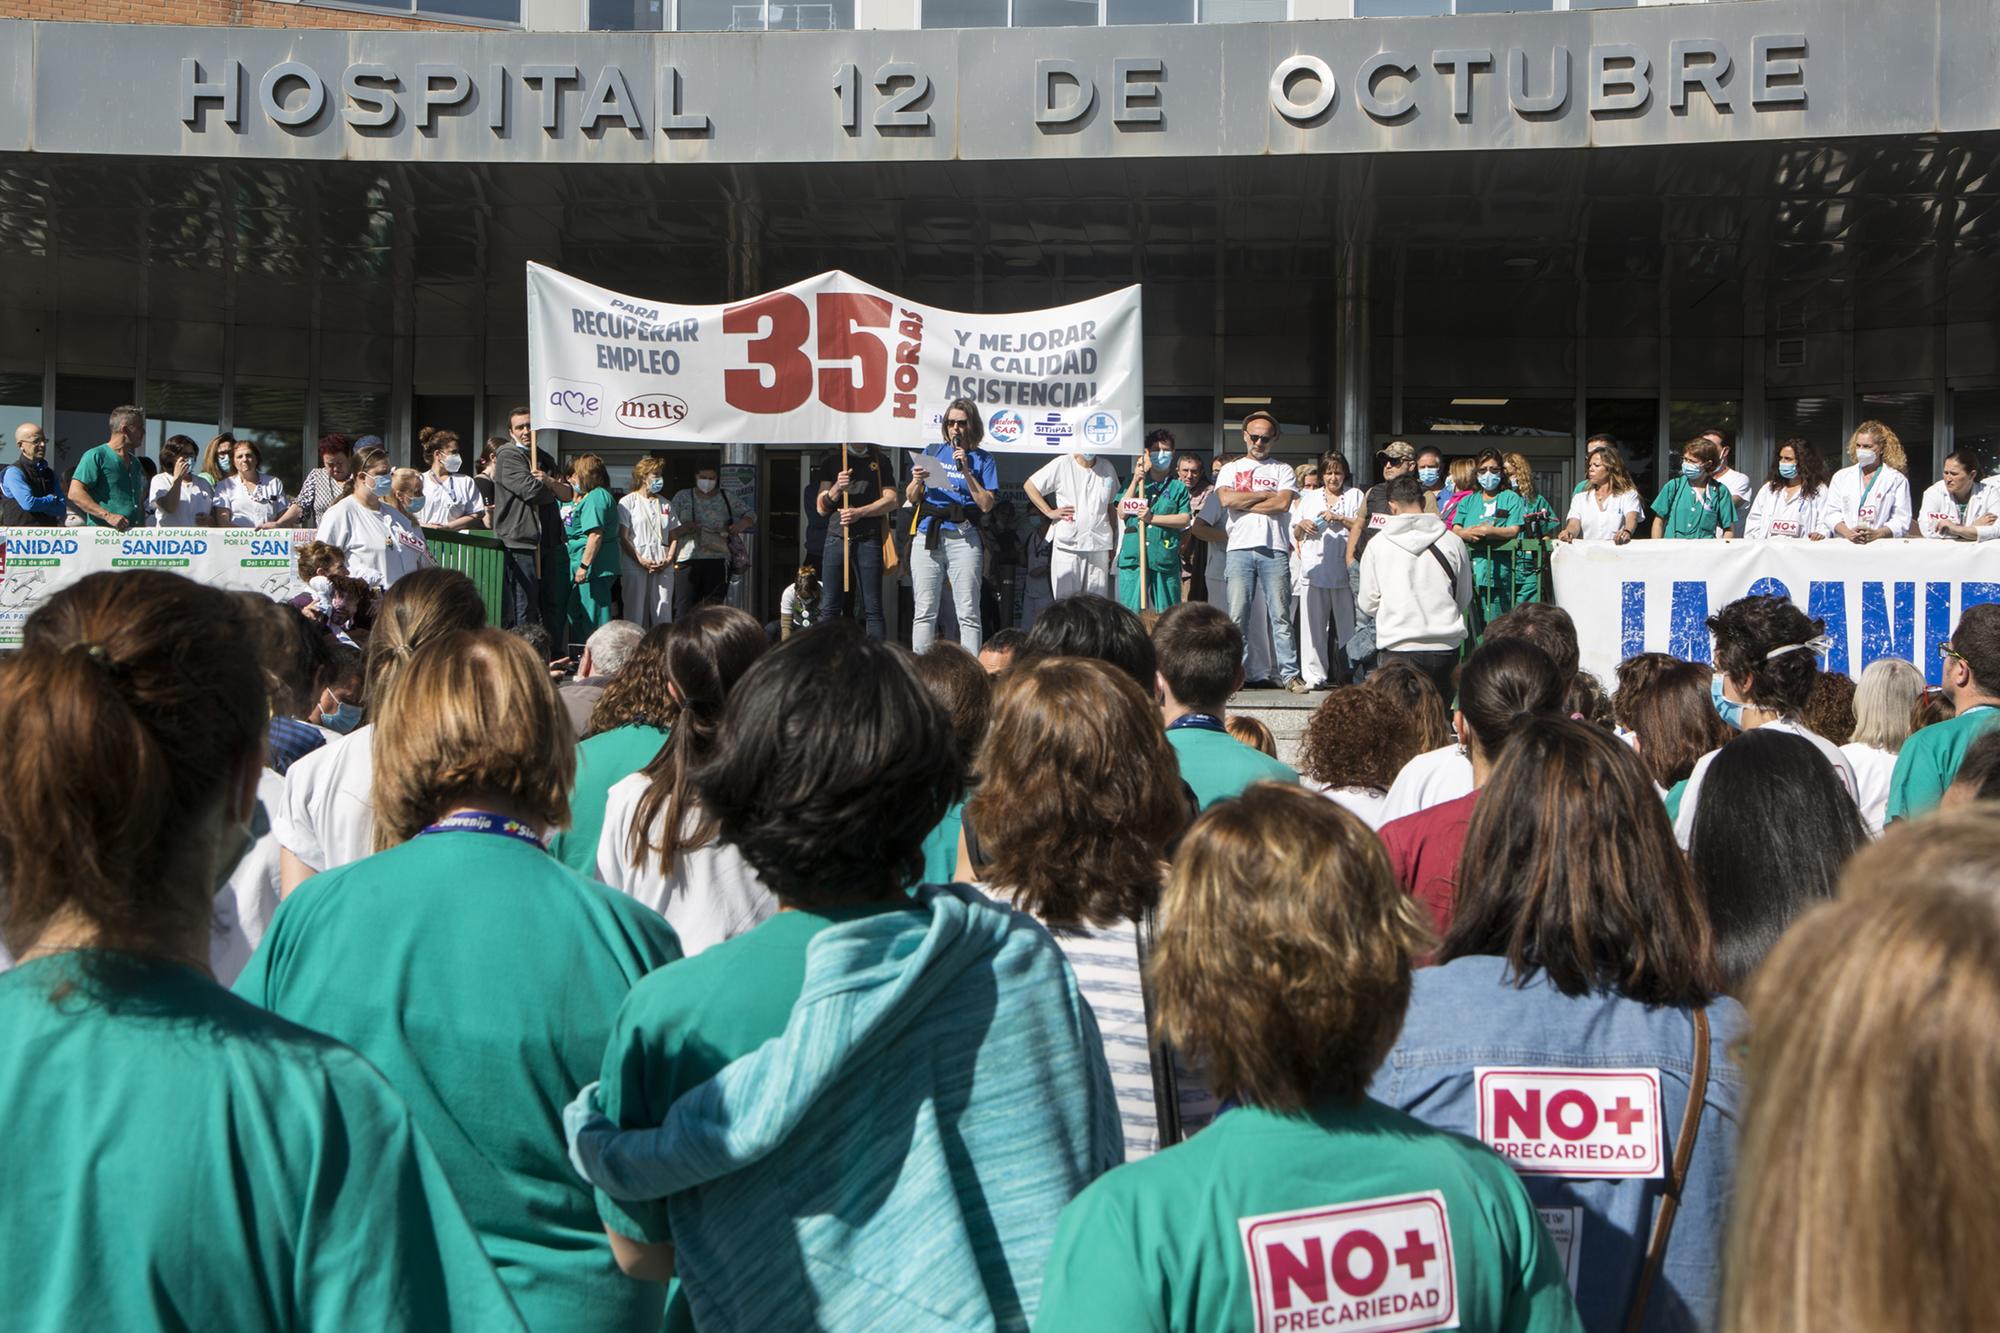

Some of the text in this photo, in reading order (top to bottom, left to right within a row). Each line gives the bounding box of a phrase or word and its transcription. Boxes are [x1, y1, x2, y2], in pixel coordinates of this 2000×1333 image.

[181, 33, 1807, 131] HOSPITAL 12 DE OCTUBRE
[610, 299, 659, 320] PARA
[572, 308, 699, 342] RECUPERAR
[954, 320, 1097, 353] Y MEJORAR
[596, 344, 680, 375] EMPLEO
[723, 292, 893, 414] 35
[893, 308, 923, 418] HORAS
[952, 347, 1098, 376] LA CALIDAD
[944, 375, 1100, 408] ASISTENCIAL
[620, 400, 685, 420] mats
[994, 426, 1017, 434] SAR
[1254, 479, 1277, 487] NO+
[1371, 516, 1386, 525] NO
[1859, 508, 1874, 517] O+
[27, 529, 79, 537] POPULAR
[224, 530, 281, 538] CONSULTA
[1772, 522, 1797, 530] NO+
[6, 539, 79, 555] ANIDAD
[122, 540, 208, 555] SANIDAD
[1493, 1088, 1644, 1141] NO+
[1493, 1143, 1646, 1159] PRECARIEDAD
[1265, 1229, 1436, 1310] NO+
[1274, 1289, 1440, 1333] PRECARIEDAD
